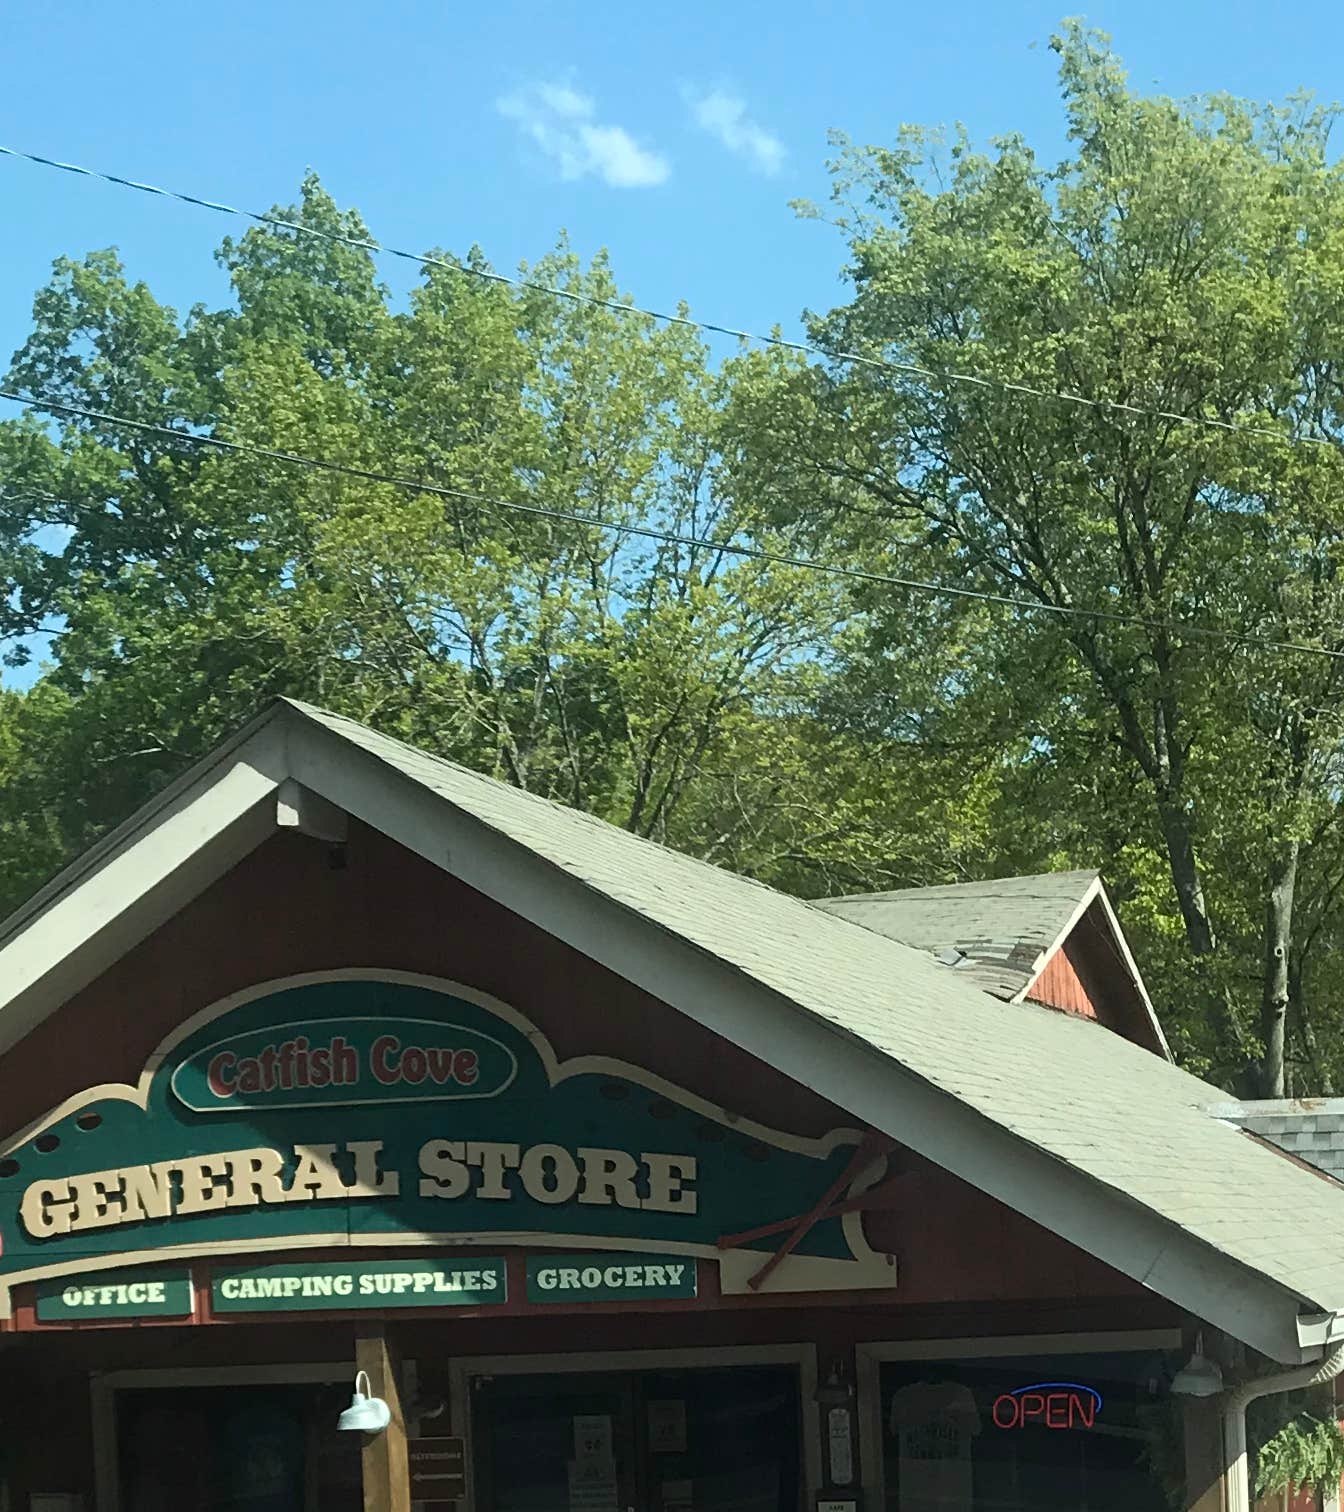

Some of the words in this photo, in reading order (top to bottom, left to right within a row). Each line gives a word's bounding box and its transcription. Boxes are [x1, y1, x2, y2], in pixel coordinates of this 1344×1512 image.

[208, 1037, 360, 1099] Catfish
[370, 1036, 480, 1086] Cove
[21, 1141, 400, 1238] GENERAL
[419, 1140, 697, 1214] STORE
[221, 1275, 354, 1300] CAMPING
[359, 1270, 498, 1296] SUPPLIES
[537, 1265, 685, 1290] GROCERY
[62, 1282, 166, 1308] OFFICE
[993, 1394, 1095, 1429] OPEN
